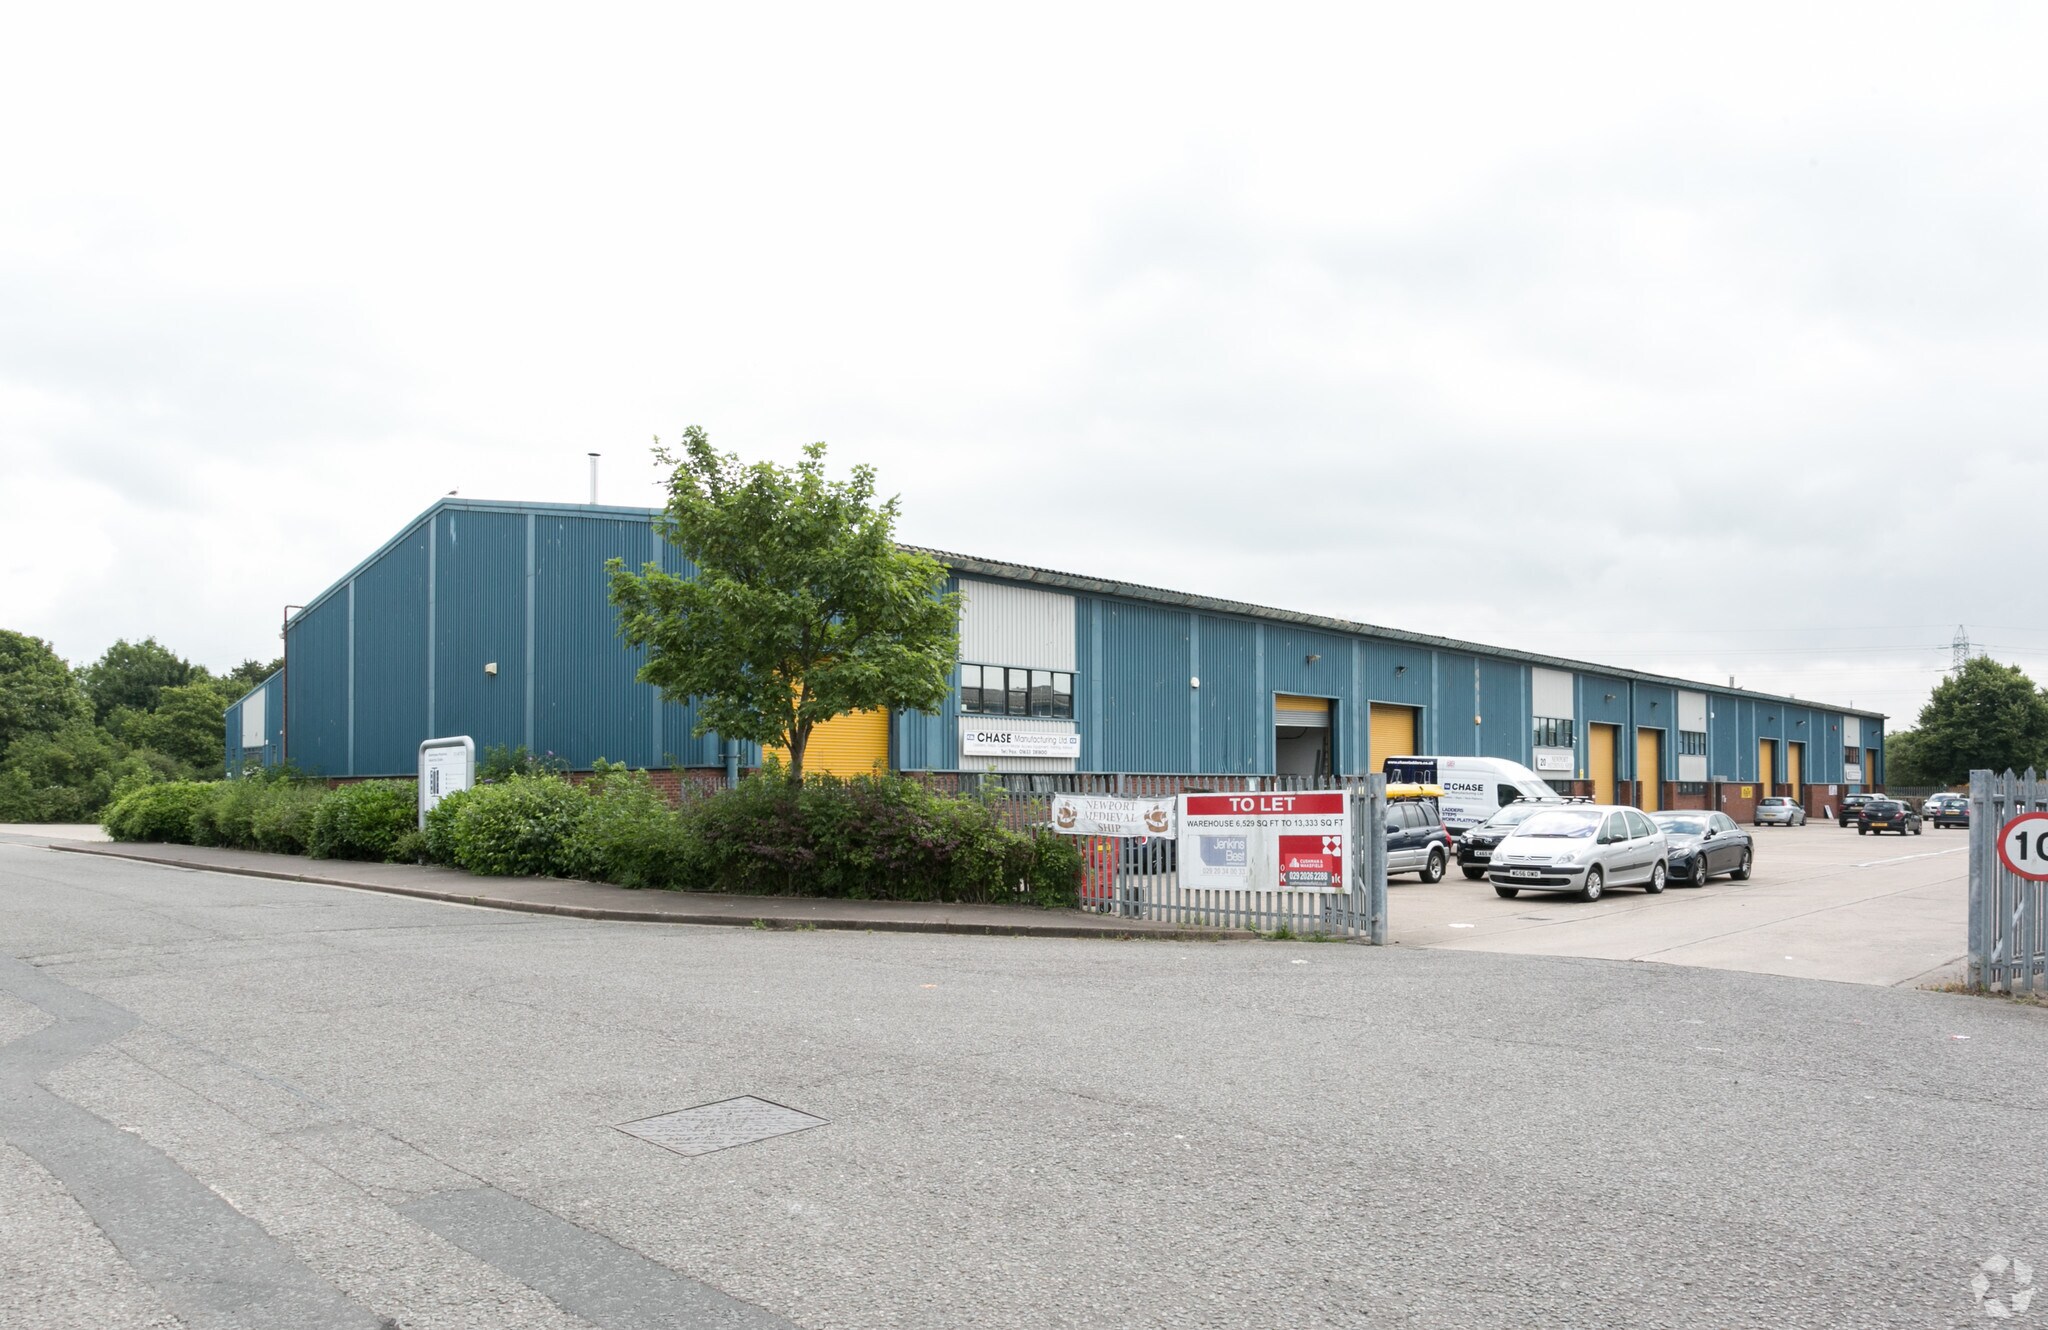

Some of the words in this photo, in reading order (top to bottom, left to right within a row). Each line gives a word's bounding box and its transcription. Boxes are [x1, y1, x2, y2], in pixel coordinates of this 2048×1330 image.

[977, 732, 1012, 744] CHASE
[1014, 734, 1057, 745] Manufacturing
[1058, 736, 1068, 744] Ltd
[1452, 783, 1484, 792] CHASE
[1086, 800, 1137, 811] NEWPORT
[1229, 798, 1255, 812] TO
[1260, 797, 1296, 811] LET
[1084, 811, 1137, 823] MEDIEVAL
[1098, 823, 1121, 833] SHIP
[1187, 820, 1234, 828] WAREHOUSE
[1235, 820, 1255, 828] 6,529
[1256, 819, 1268, 828] SQ
[1269, 819, 1279, 827] FT
[1281, 819, 1292, 827] TO
[1294, 818, 1319, 828] 13,333
[1320, 818, 1332, 827] SQ
[1334, 818, 1344, 827] FT
[1213, 837, 1245, 850] Jenkins
[1225, 849, 1245, 862] Best
[1289, 871, 1300, 880] 029
[1300, 871, 1314, 881] 2026
[1314, 871, 1328, 881] 2288
